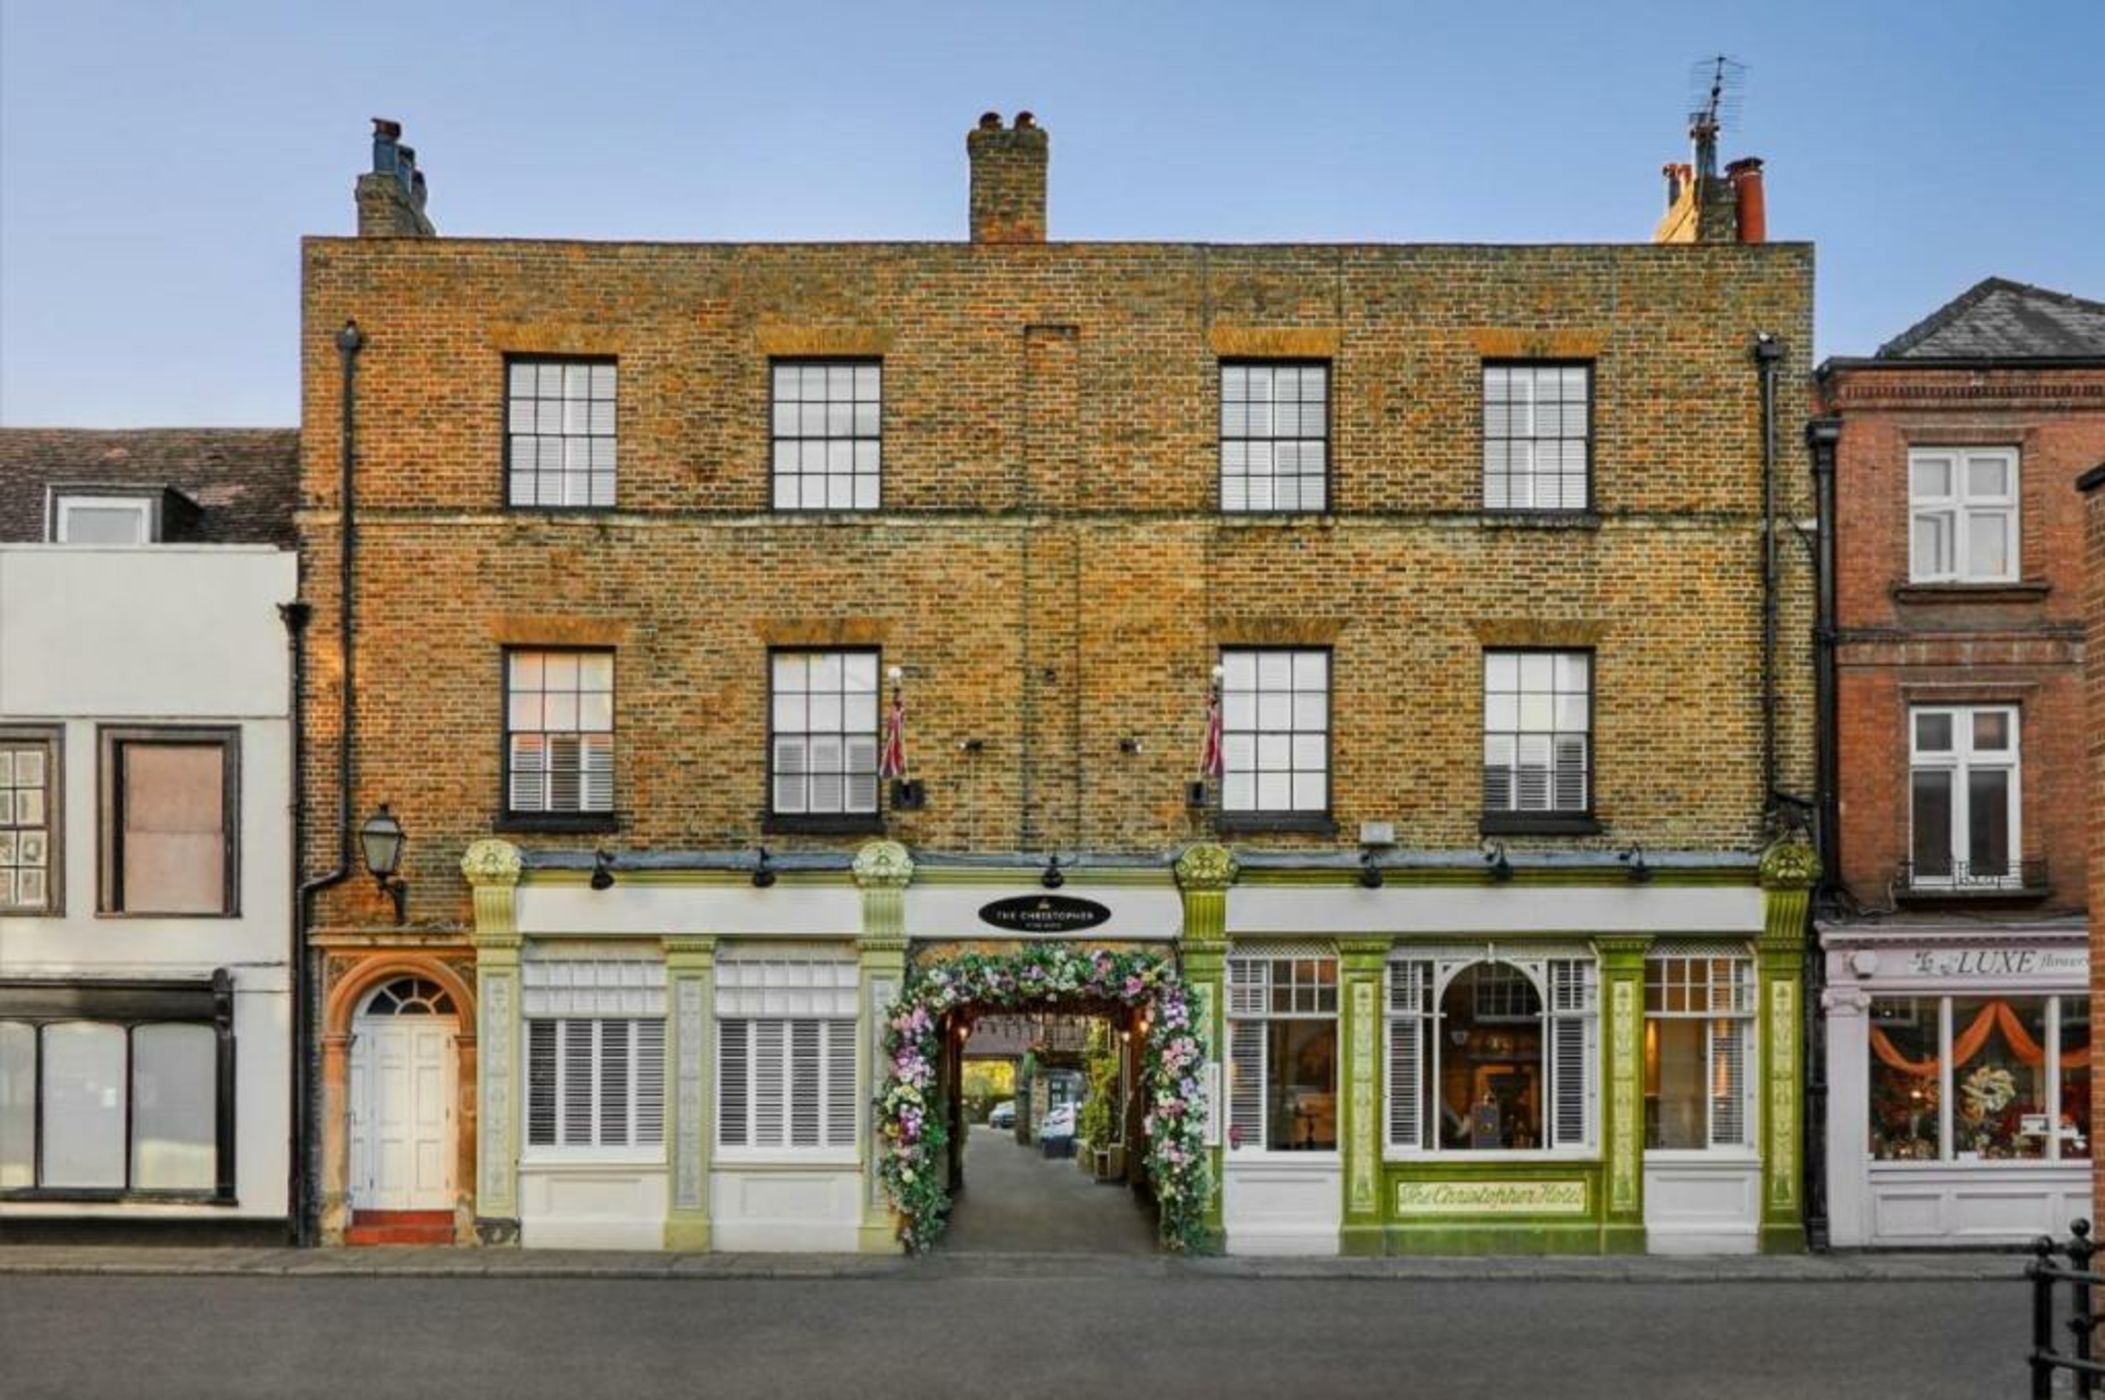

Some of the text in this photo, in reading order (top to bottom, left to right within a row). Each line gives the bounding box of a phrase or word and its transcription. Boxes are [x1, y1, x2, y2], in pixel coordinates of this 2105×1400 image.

[997, 911, 1094, 921] THE CHRISTOPHER
[1957, 951, 2036, 974] LUXE
